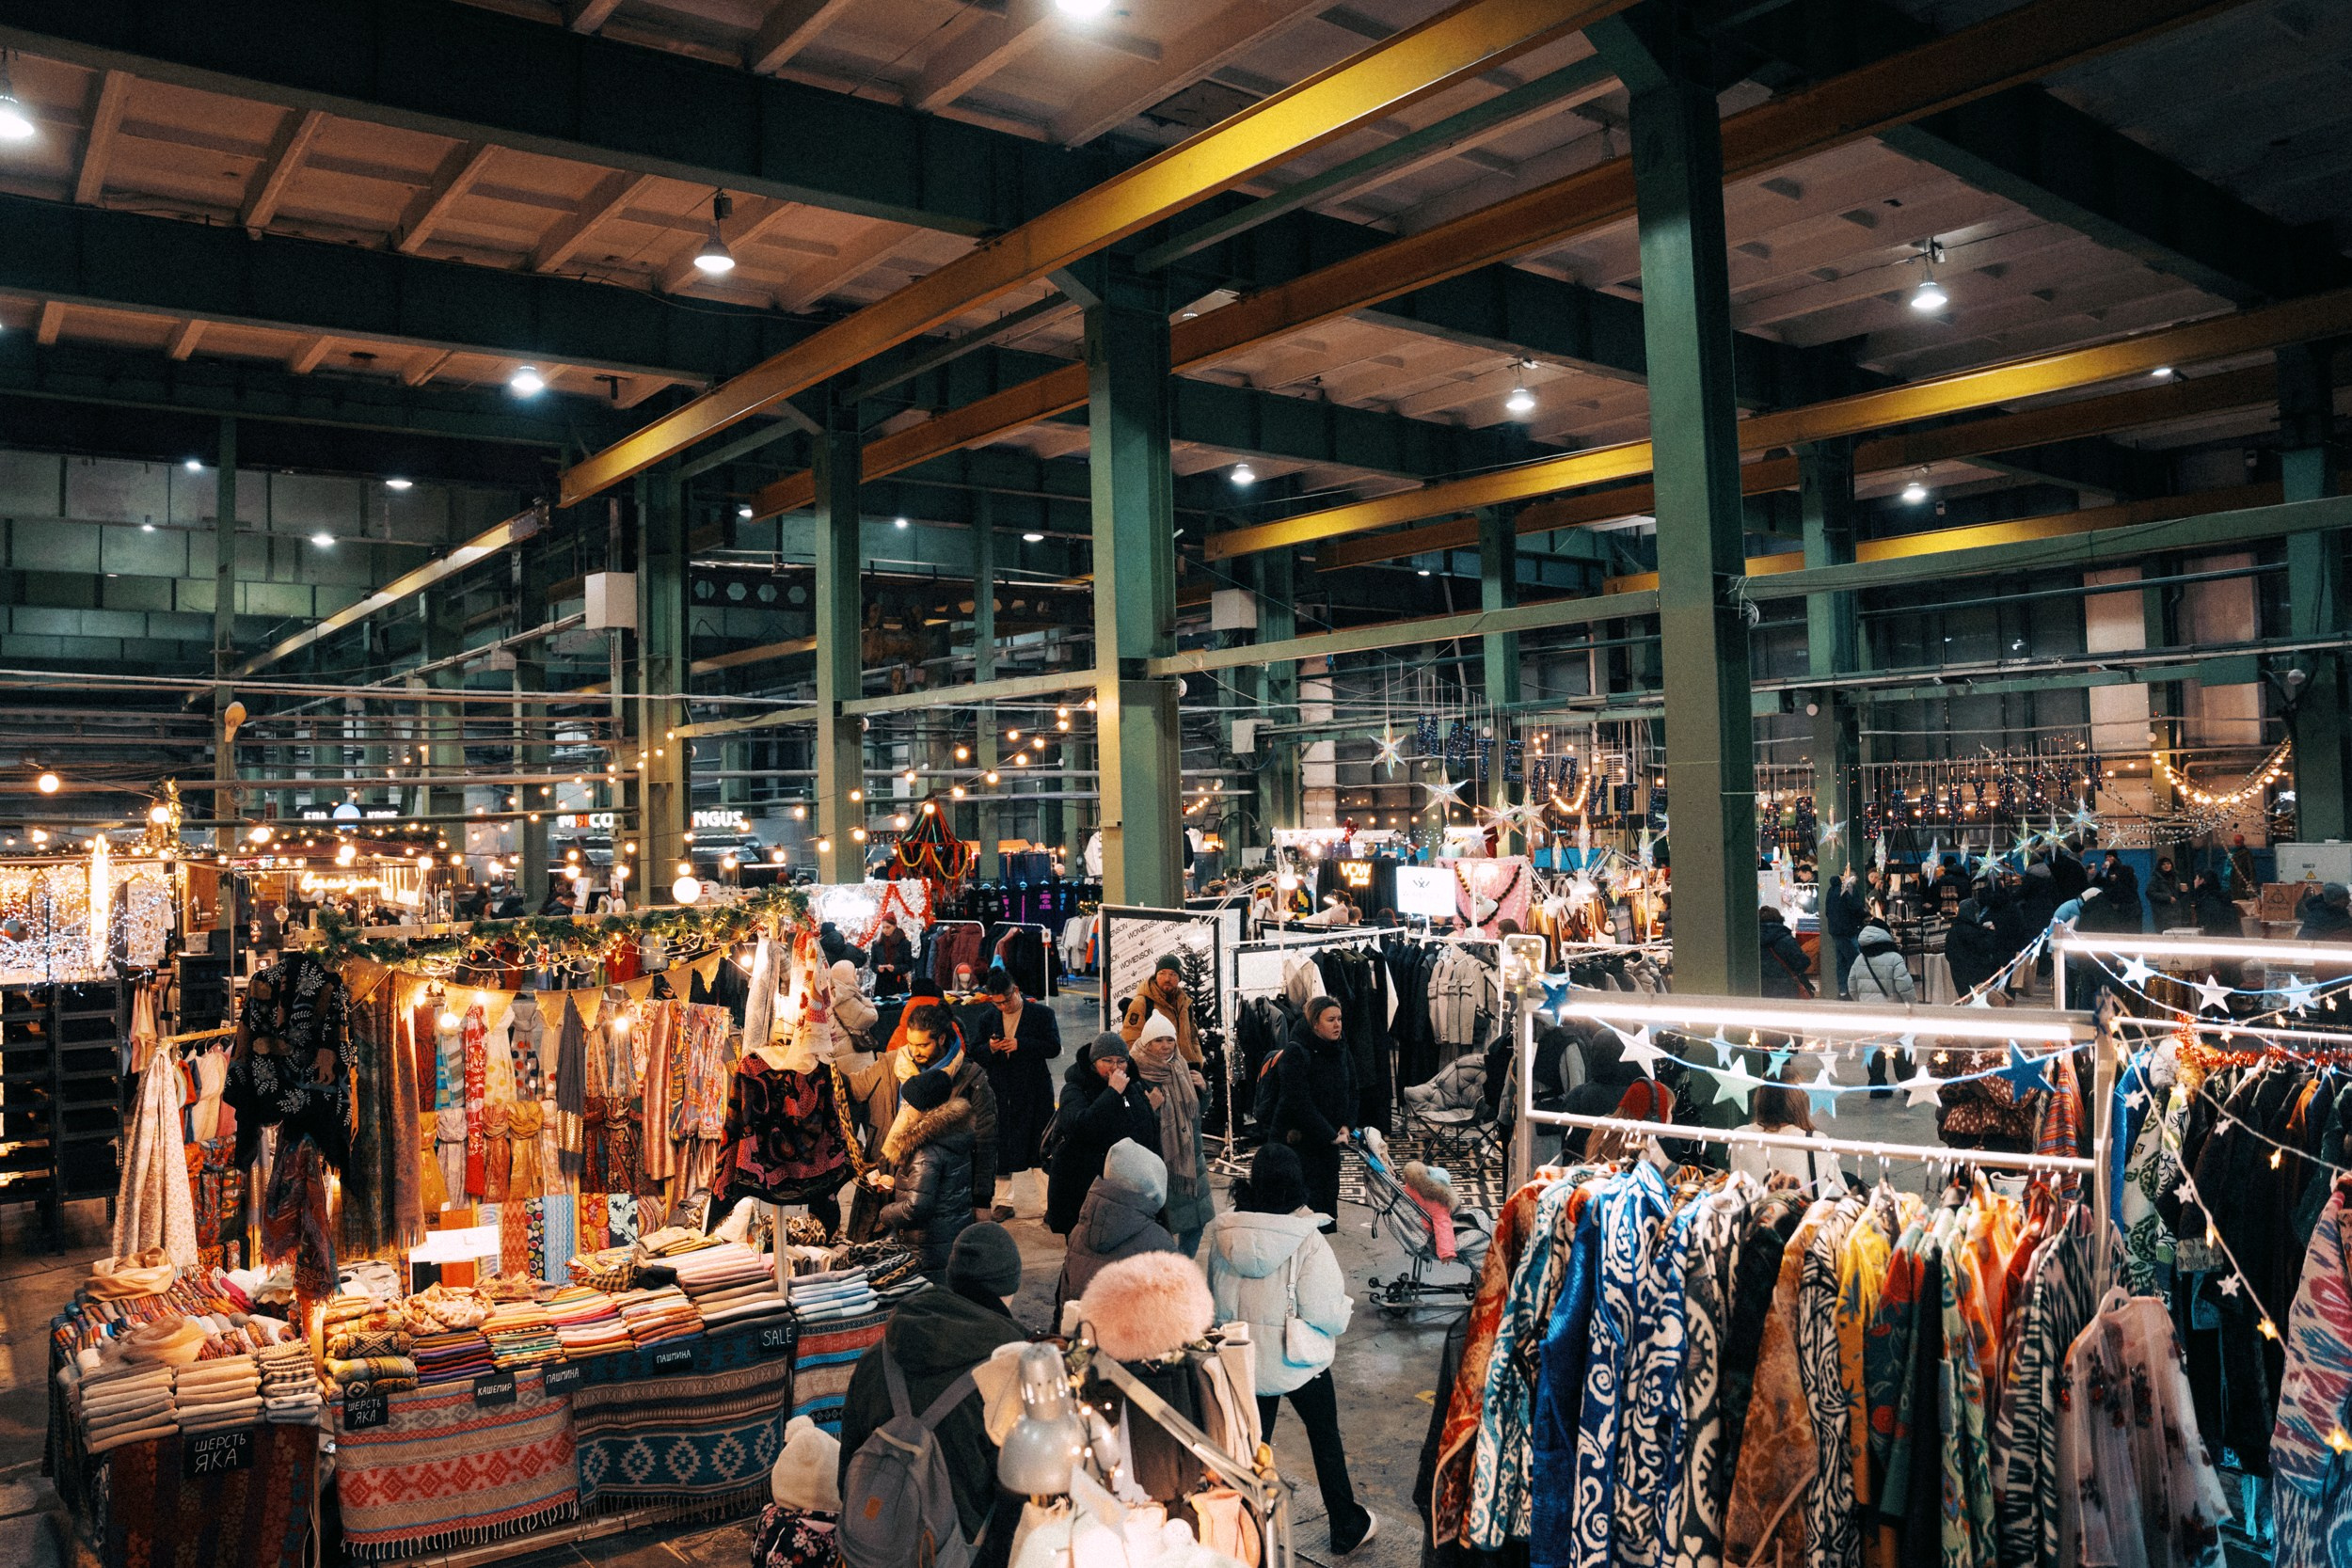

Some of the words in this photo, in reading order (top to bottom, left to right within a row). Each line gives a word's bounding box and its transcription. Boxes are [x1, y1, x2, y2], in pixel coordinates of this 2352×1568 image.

[558, 814, 613, 828] МЯСО
[691, 811, 743, 828] NGUS
[1120, 947, 1153, 970] WOMENSON
[762, 1327, 792, 1347] SALE
[656, 1349, 691, 1364] ПАШМИНА
[546, 1368, 580, 1385] ПАШМИНА
[477, 1383, 512, 1396] КАШЕМИР
[347, 1398, 381, 1412] ШЕРСТЬ
[355, 1409, 376, 1425] ЯКА
[195, 1433, 246, 1452] ШЕРСТЬ
[195, 1449, 237, 1473] ЯКА
